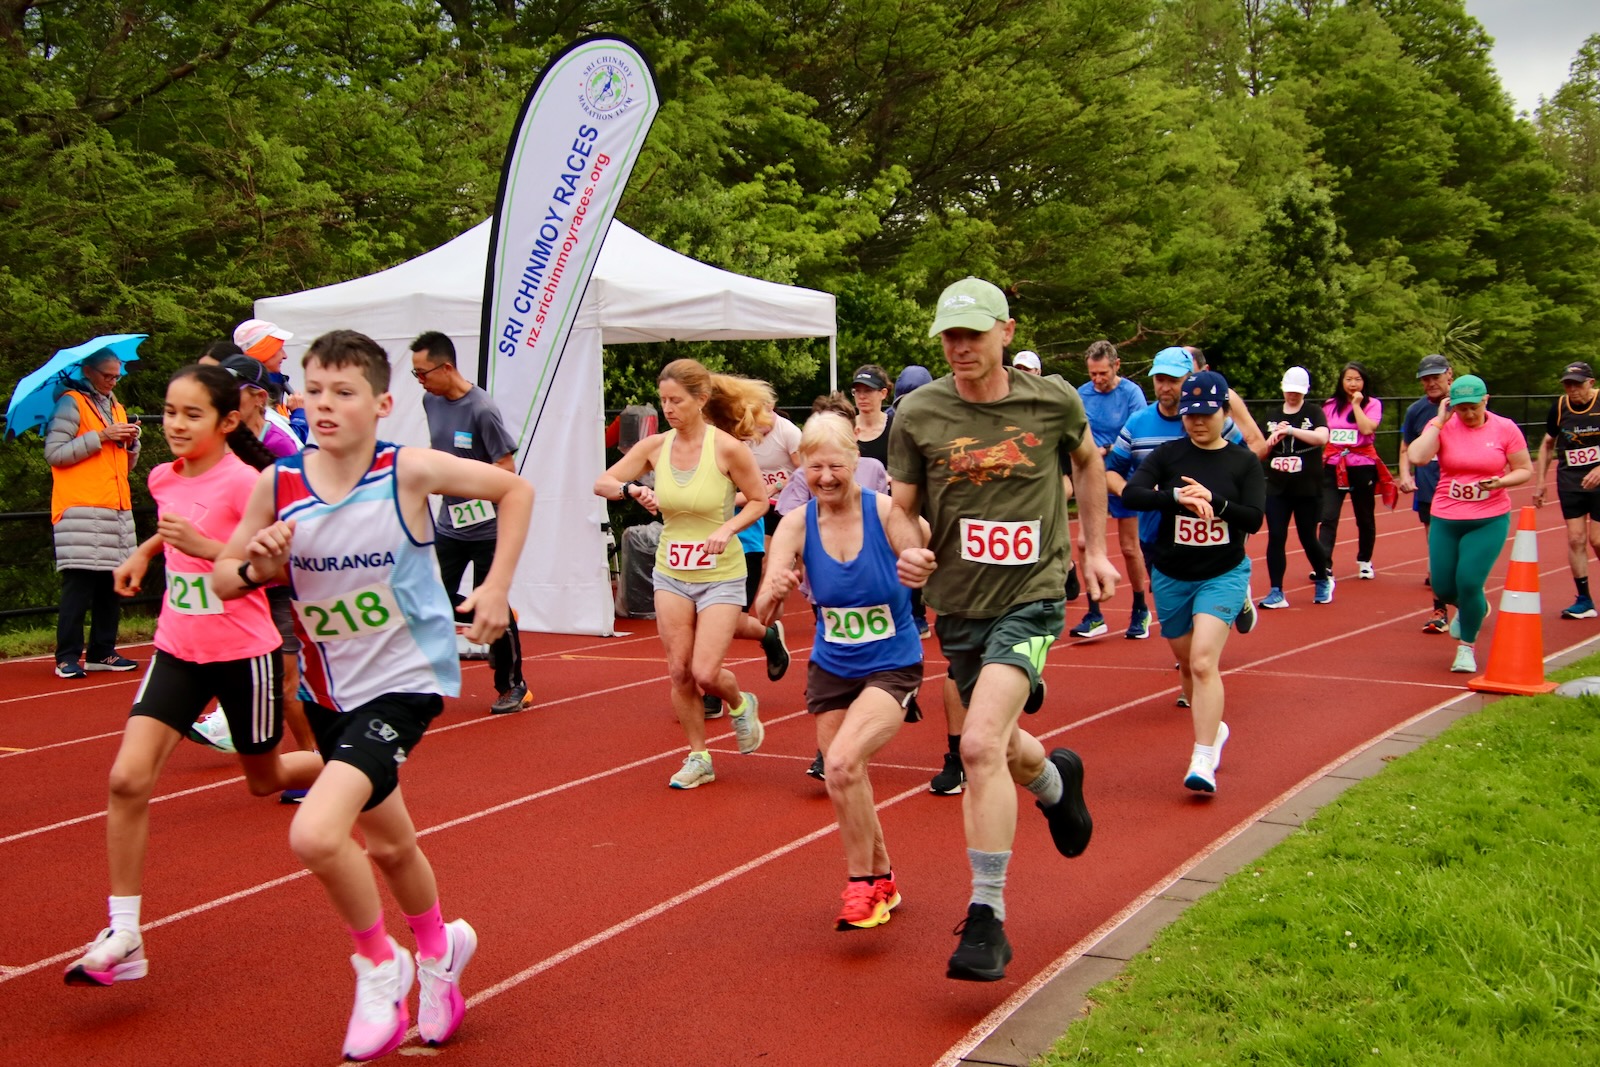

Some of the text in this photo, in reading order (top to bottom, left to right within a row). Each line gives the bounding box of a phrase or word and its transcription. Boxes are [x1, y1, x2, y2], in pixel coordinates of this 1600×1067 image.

[583, 56, 632, 77] SRI CHINMOY
[578, 94, 633, 120] MARATHON TEAM
[498, 124, 598, 358] SRI CHINMOY RACES
[526, 153, 611, 349] nz.srichinmoyraces.org
[1331, 430, 1356, 442] 224
[1273, 458, 1299, 472] 567
[1568, 448, 1599, 465] 582
[453, 500, 487, 525] 211
[966, 524, 1034, 561] 566
[1178, 519, 1225, 544] 585
[291, 551, 396, 572] AKURANGA
[669, 543, 711, 567] 572
[303, 591, 390, 636] 218
[826, 608, 889, 639] 206
